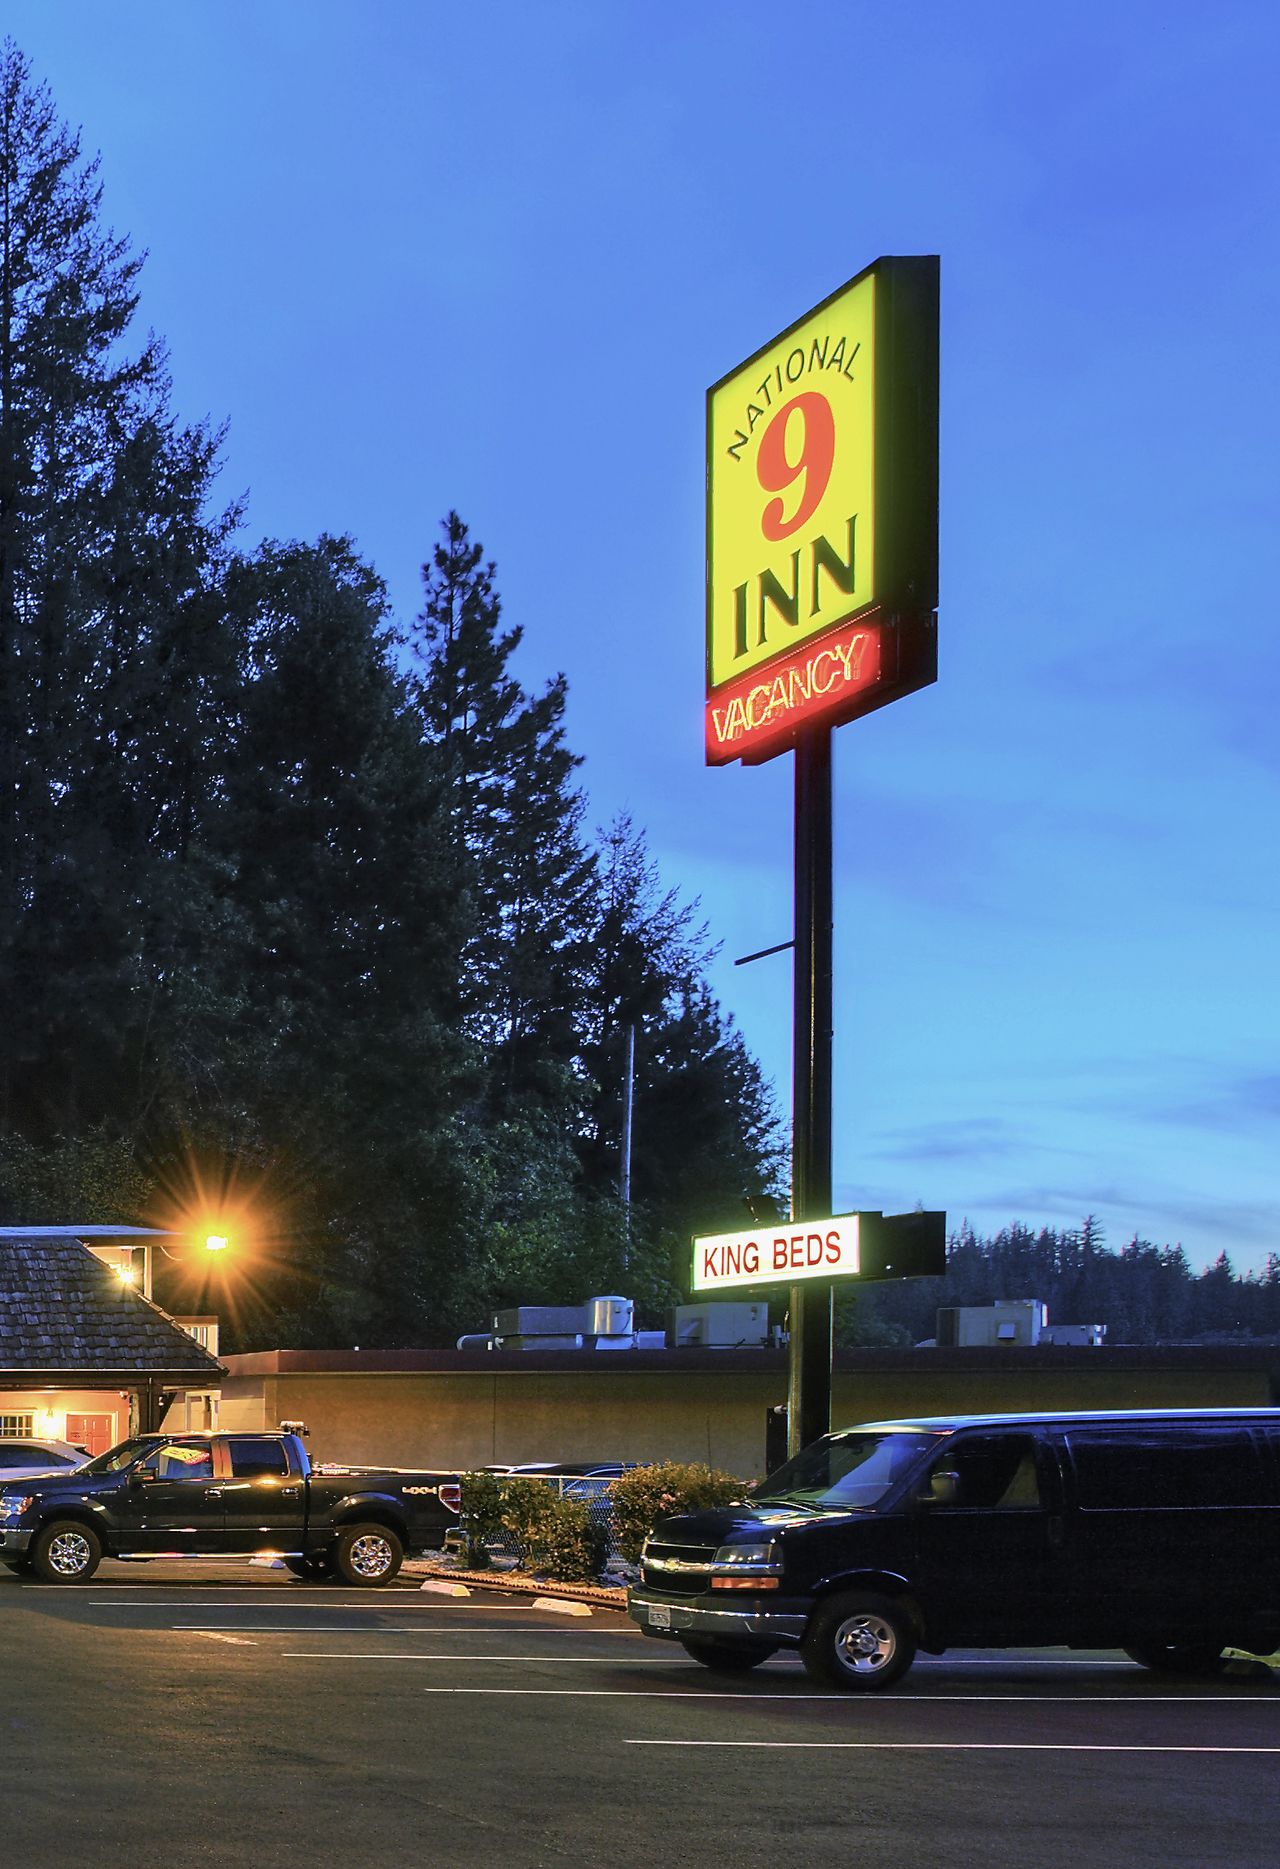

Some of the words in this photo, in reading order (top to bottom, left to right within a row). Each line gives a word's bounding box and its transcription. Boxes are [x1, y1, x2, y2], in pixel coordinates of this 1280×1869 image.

[726, 335, 861, 462] NATIONAL
[756, 391, 835, 542] 9
[732, 513, 859, 661] INN
[711, 633, 865, 743] VACANCY
[703, 1242, 759, 1278] KING
[773, 1231, 841, 1270] BEDS
